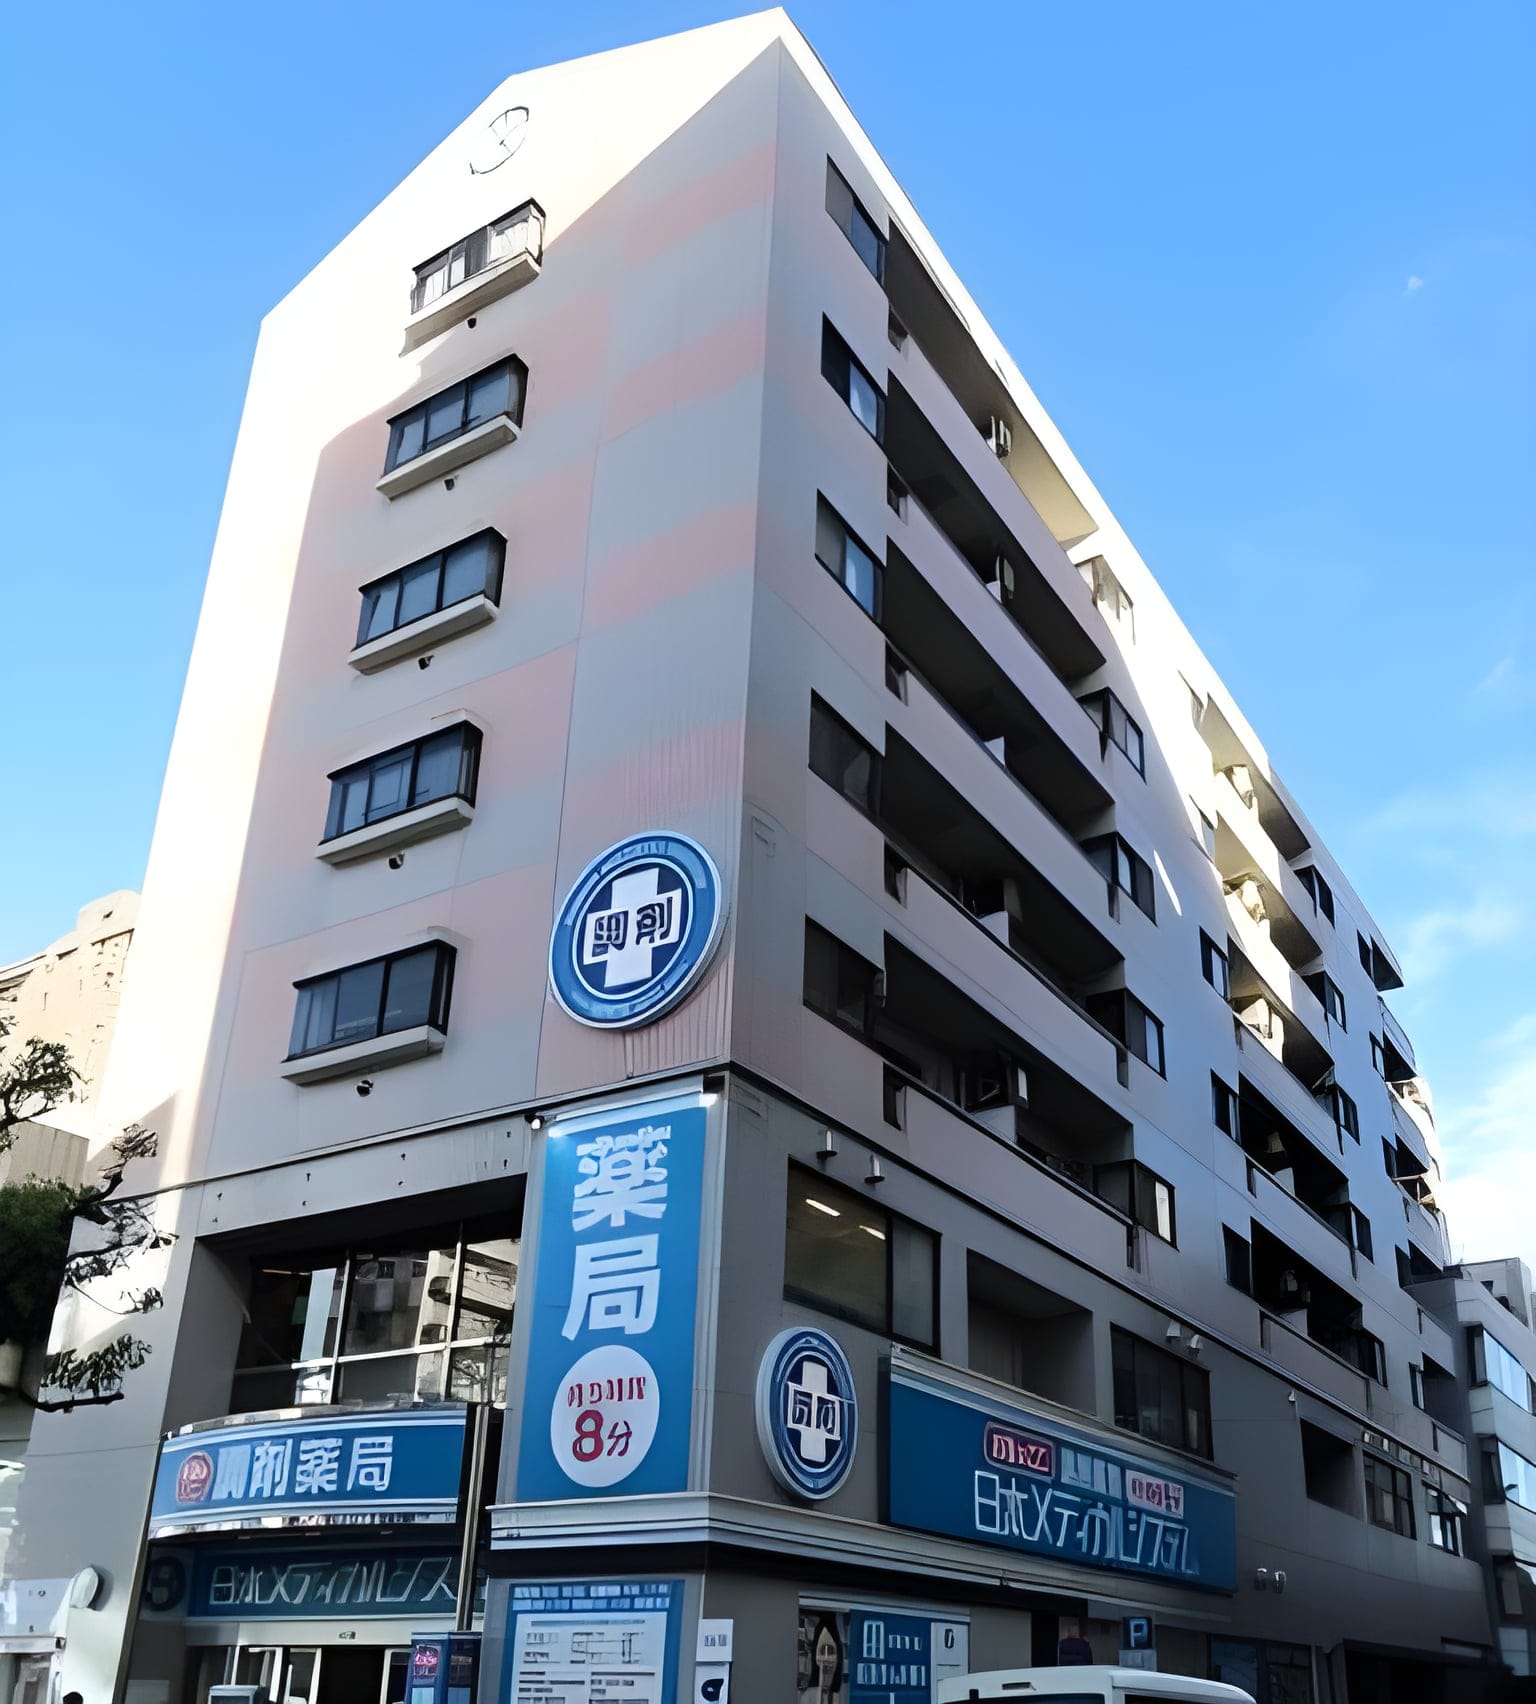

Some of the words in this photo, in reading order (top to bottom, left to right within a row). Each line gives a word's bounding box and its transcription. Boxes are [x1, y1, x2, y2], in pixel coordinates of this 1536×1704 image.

[561, 1125, 671, 1341] 薬局
[572, 1409, 632, 1462] 8分
[211, 1436, 394, 1500] 剤薬局
[1130, 1619, 1149, 1648] P
